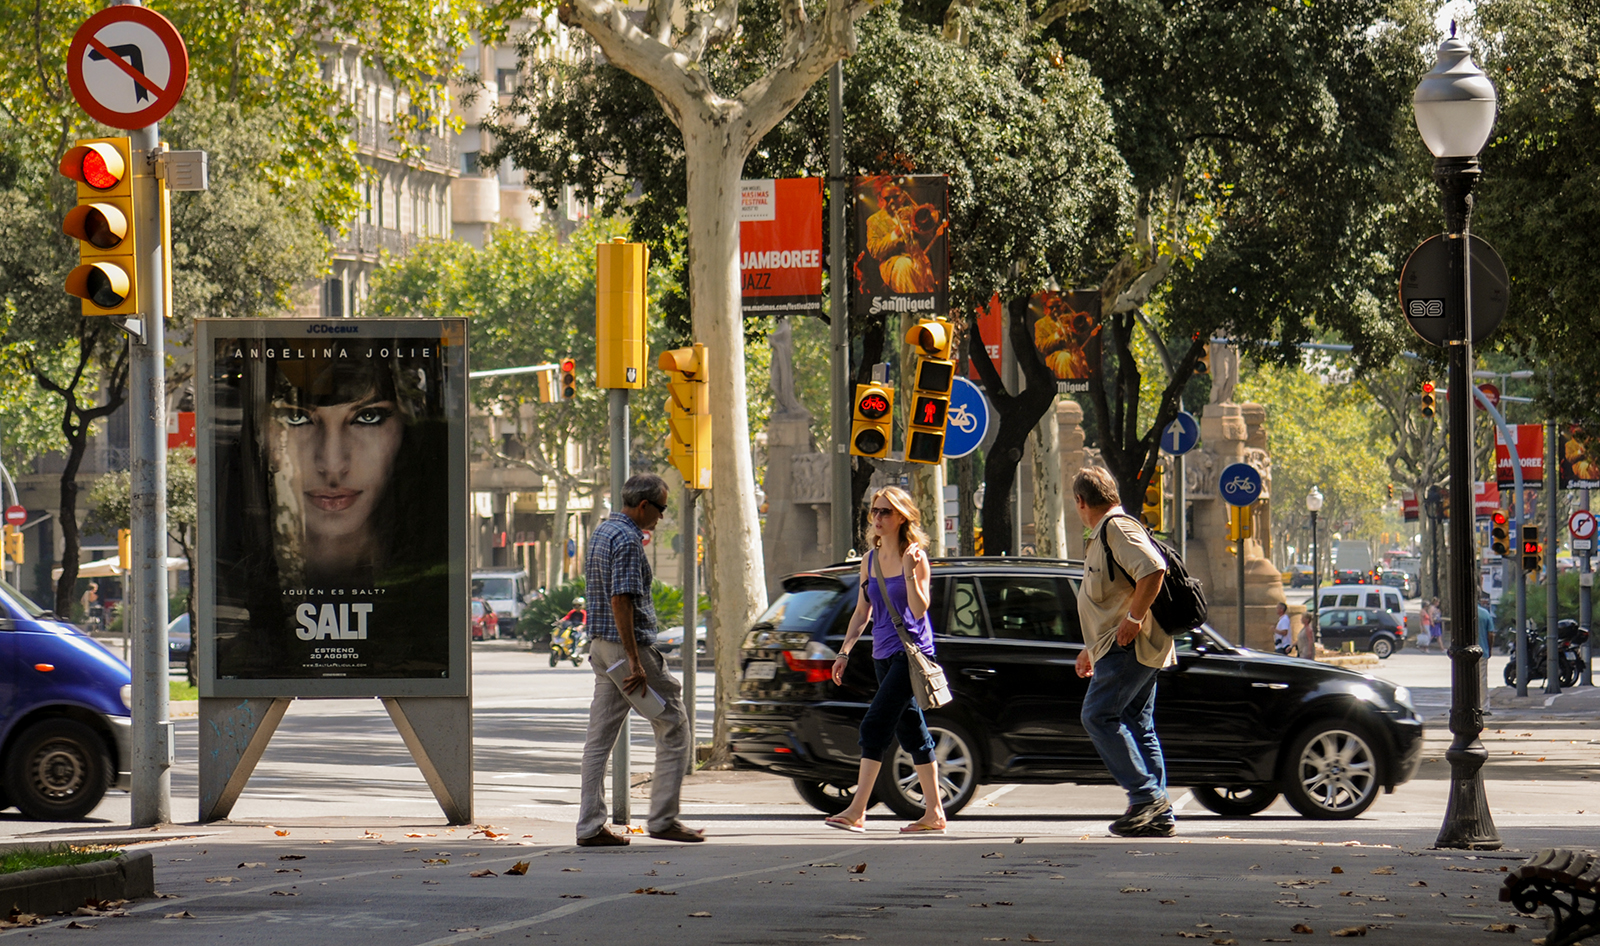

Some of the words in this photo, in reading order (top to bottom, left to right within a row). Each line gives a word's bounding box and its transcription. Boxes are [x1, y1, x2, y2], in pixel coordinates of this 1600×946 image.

[740, 250, 819, 270] JAMBOREE
[742, 273, 771, 290] JAZZ
[307, 324, 359, 334] JCDecaux
[234, 349, 348, 358] ANGELINA
[366, 348, 430, 358] JOLIE
[282, 588, 324, 596] ¿QUIÉN
[295, 603, 373, 640] SALT
